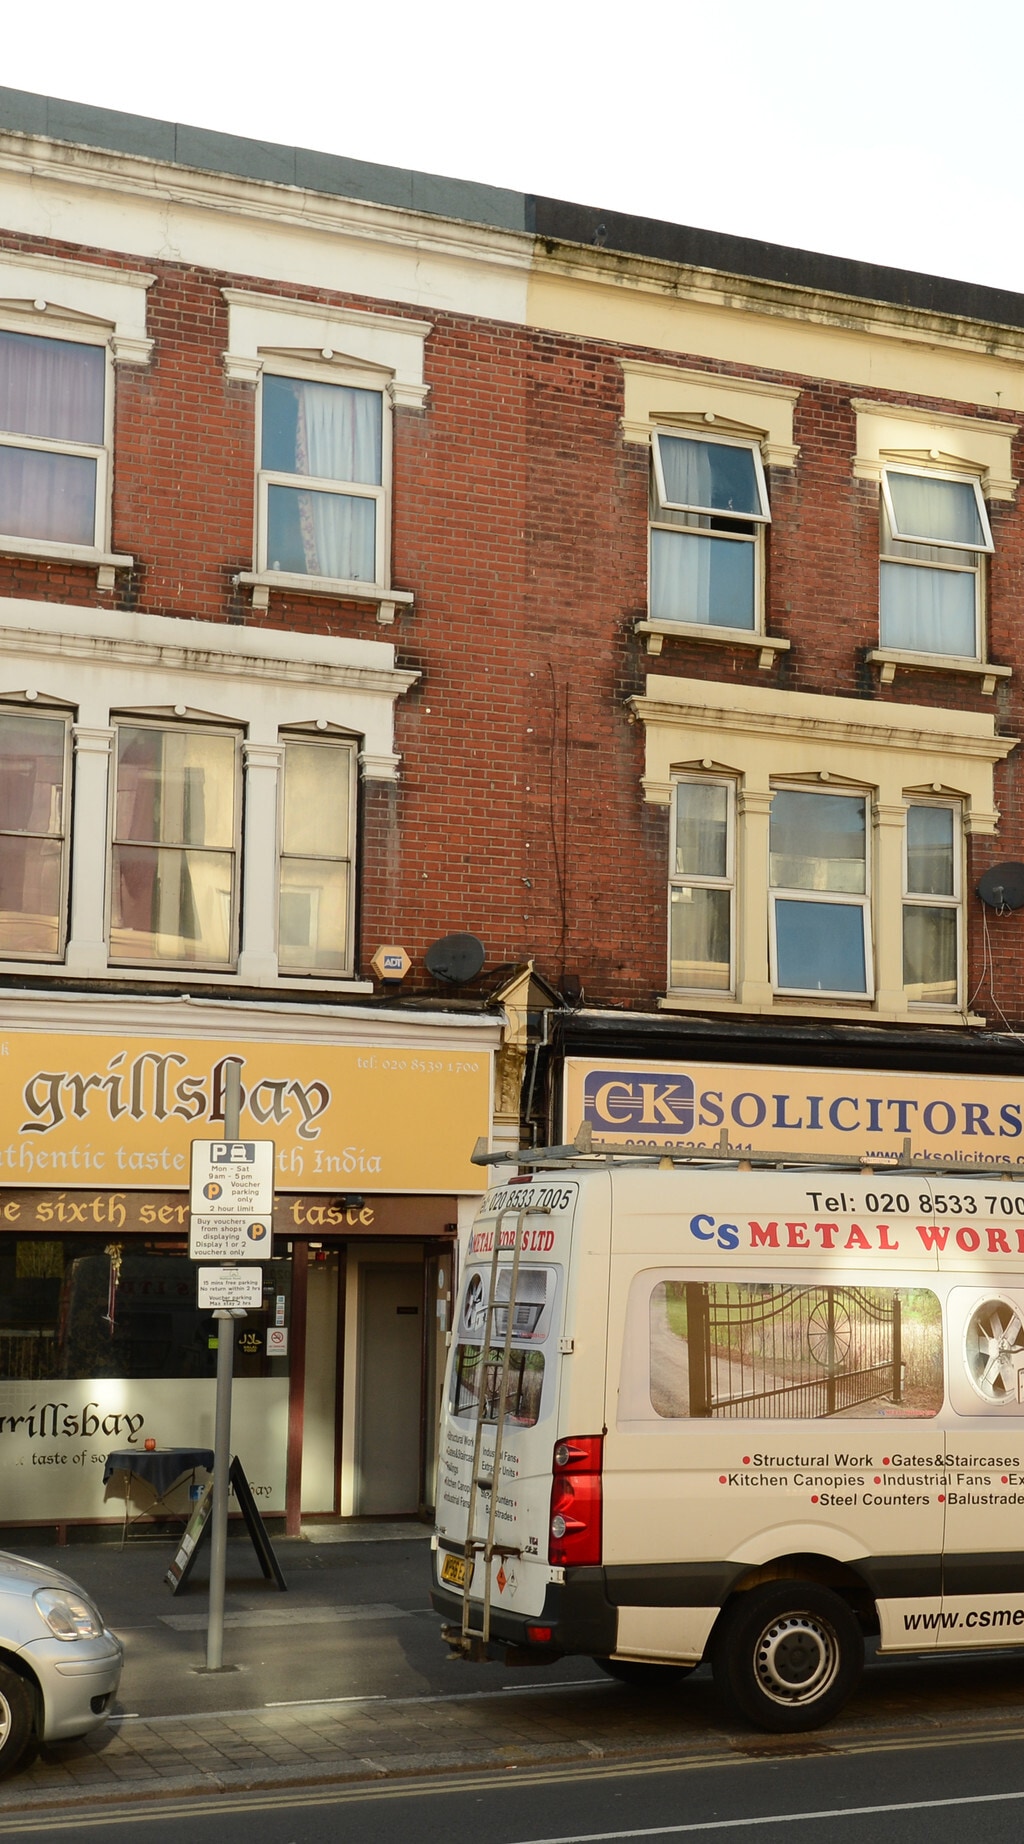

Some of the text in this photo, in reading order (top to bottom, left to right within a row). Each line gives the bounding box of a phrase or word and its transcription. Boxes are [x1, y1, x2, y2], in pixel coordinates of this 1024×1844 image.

[384, 958, 402, 968] ADT
[382, 1060, 407, 1070] 020
[411, 1059, 443, 1072] 8539
[447, 1062, 479, 1073] 1700
[18, 1051, 332, 1141] grillsbay
[595, 1081, 1023, 1138] CK SOLICITORS
[0, 1141, 105, 1173] thentic
[115, 1146, 186, 1171] taste
[313, 1147, 383, 1174] India
[535, 1188, 573, 1210] 7005
[806, 1192, 856, 1212] Tel:
[864, 1193, 911, 1213] 020
[917, 1194, 979, 1214] 8533
[36, 1194, 127, 1228] sixth
[529, 1230, 555, 1252] LTD
[747, 1221, 900, 1250] METAL
[32, 1452, 68, 1466] taste
[72, 1450, 87, 1467] of
[753, 1454, 829, 1467] Structural
[834, 1454, 874, 1467] Work
[891, 1454, 1020, 1467] Gates&Staircases
[728, 1473, 788, 1486] Kitchen
[793, 1473, 865, 1489] Canopies
[883, 1473, 952, 1486] Industrial
[957, 1473, 991, 1486] Fans
[819, 1493, 857, 1506] Steel
[862, 1494, 930, 1506] Counters
